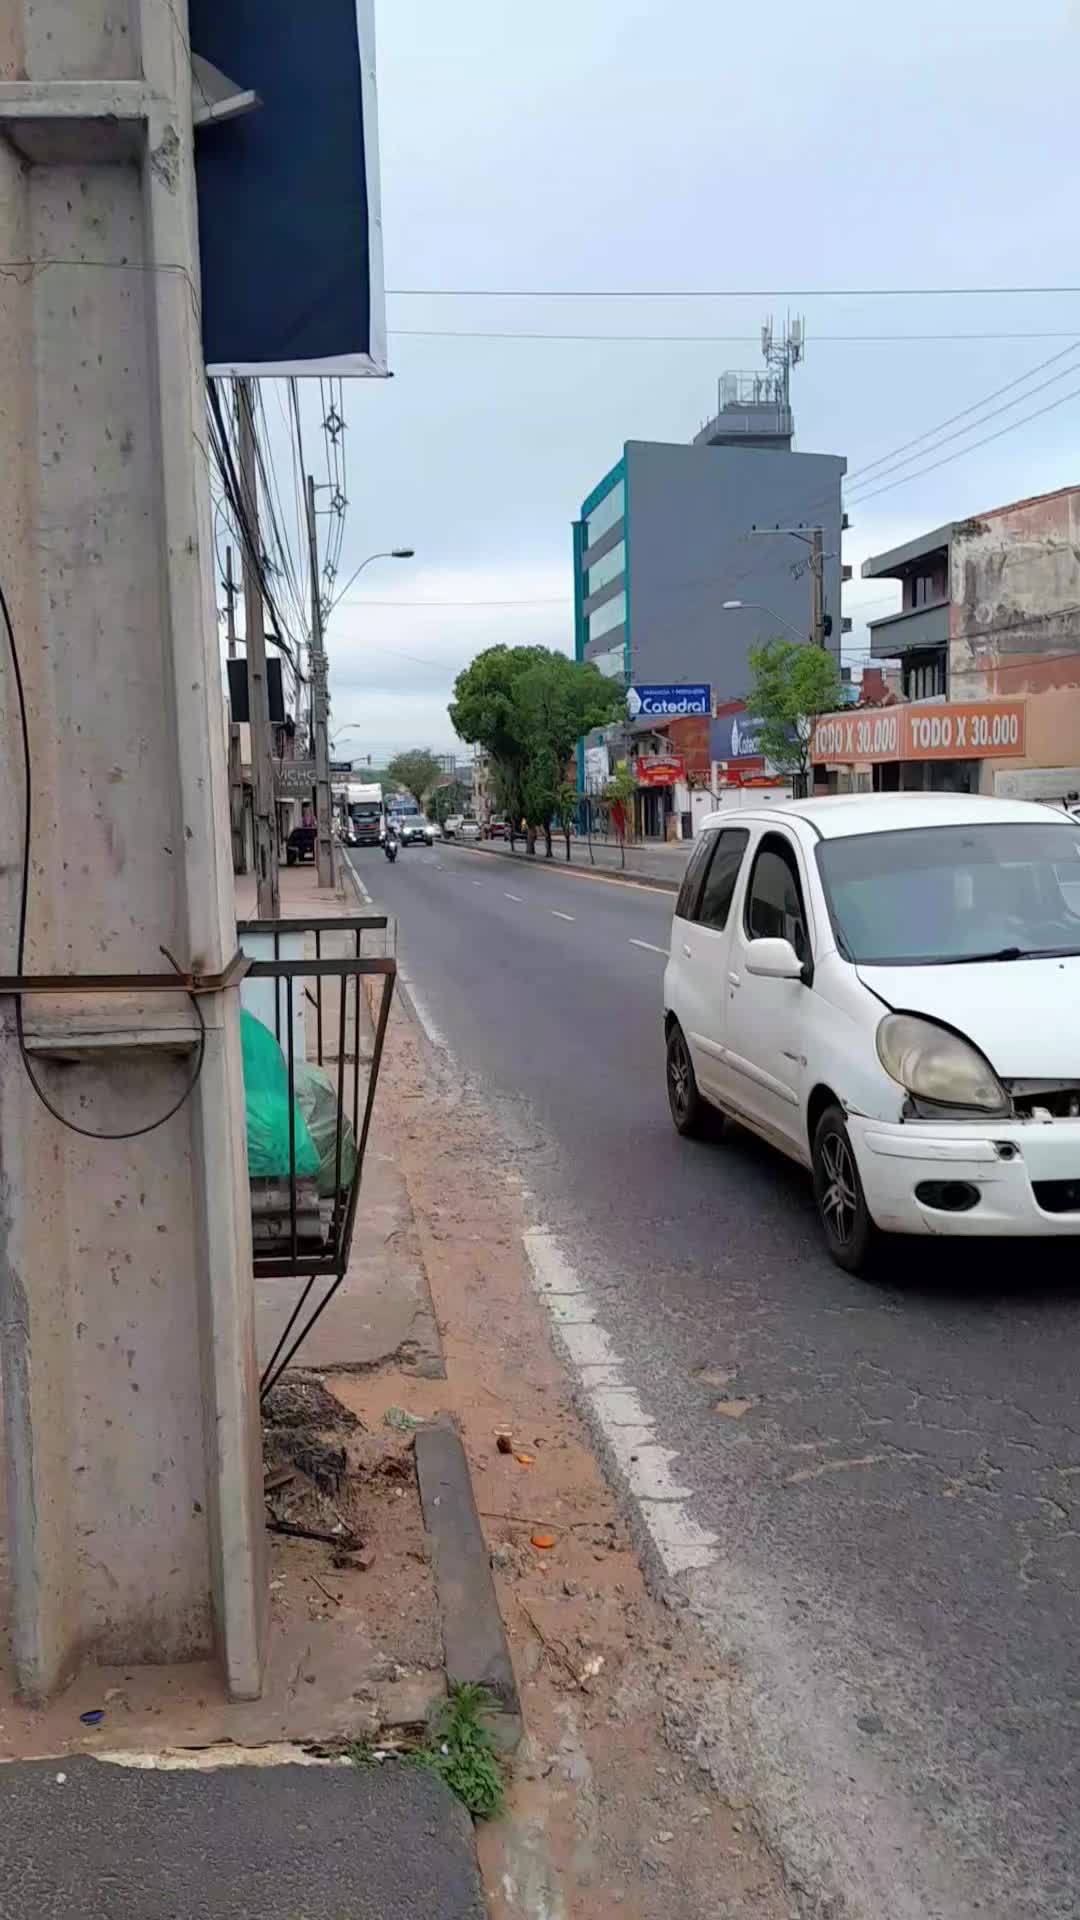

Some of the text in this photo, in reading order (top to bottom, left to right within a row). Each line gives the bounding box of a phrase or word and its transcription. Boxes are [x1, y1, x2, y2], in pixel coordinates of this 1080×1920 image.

[642, 696, 706, 713] Catedral
[815, 717, 897, 754] TODO X 30.000
[911, 714, 1018, 749] TODO X 30.000
